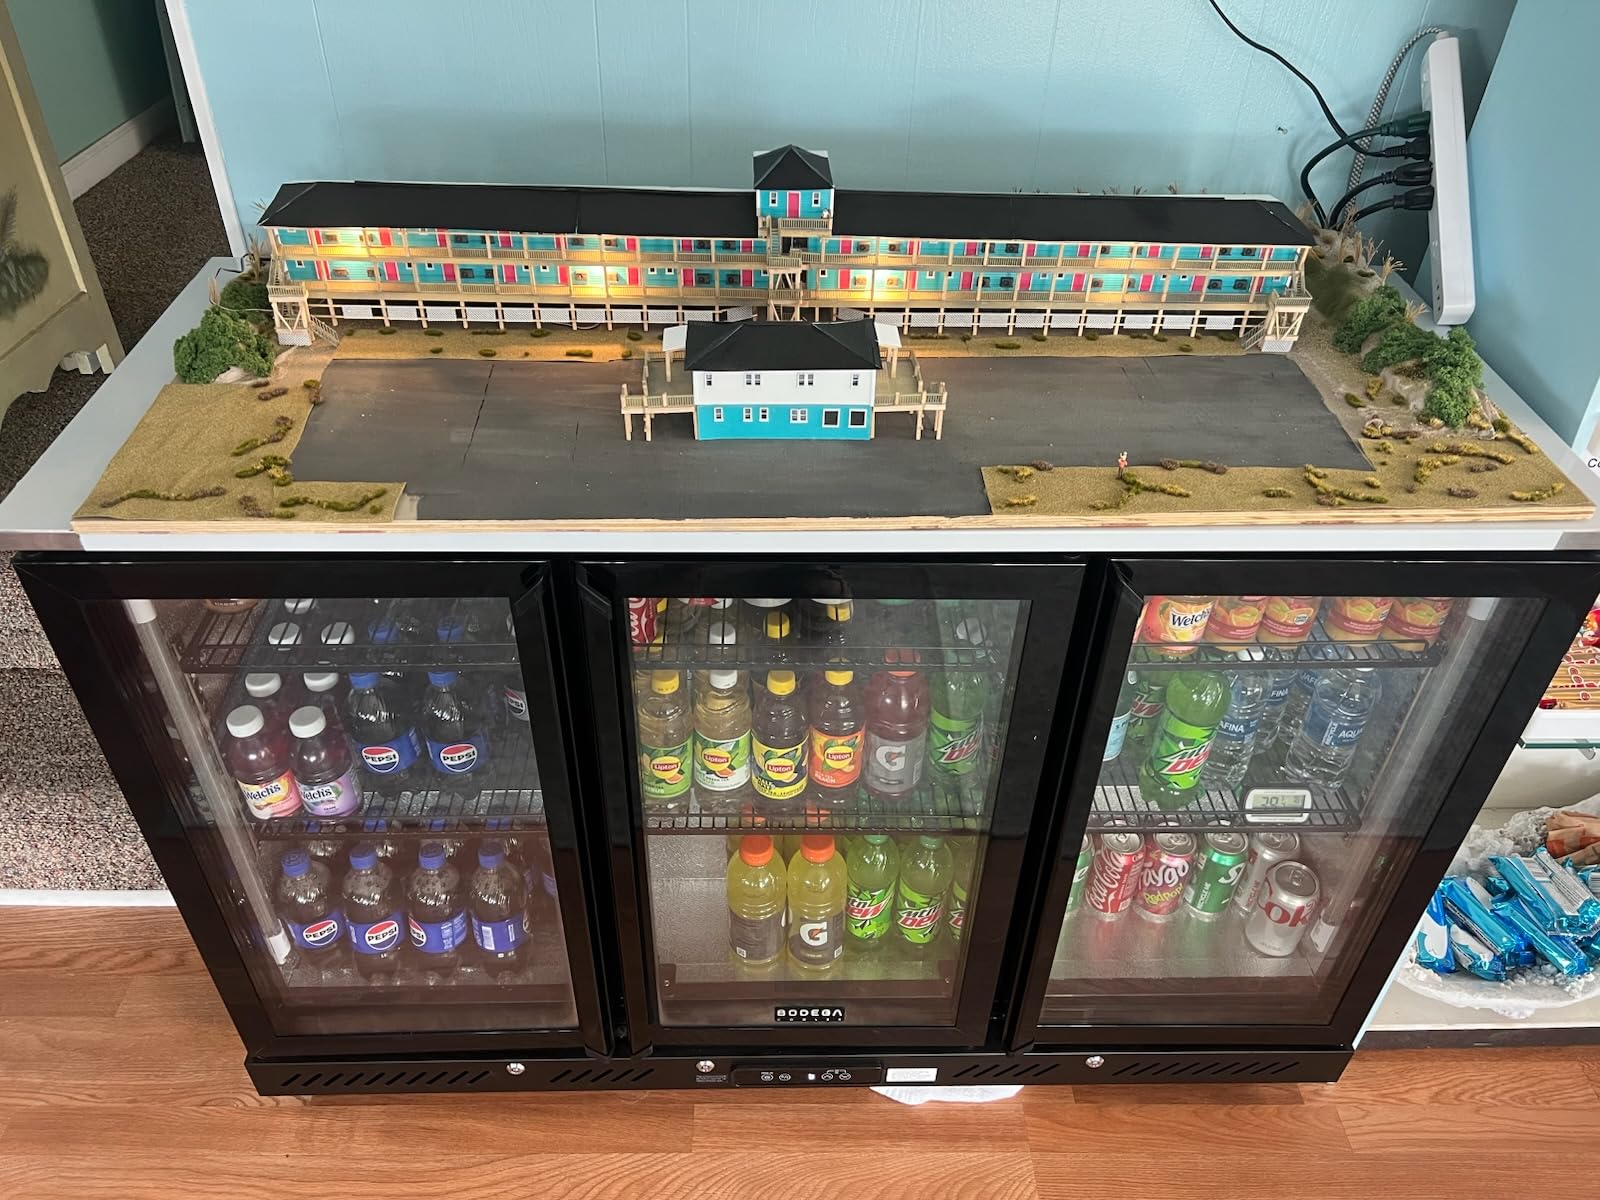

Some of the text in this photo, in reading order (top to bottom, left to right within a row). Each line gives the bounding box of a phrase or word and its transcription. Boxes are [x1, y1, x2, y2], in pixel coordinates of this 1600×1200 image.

[1271, 688, 1288, 697] FINA
[1219, 720, 1245, 732] AFINA
[364, 754, 397, 762] PEPSI
[442, 750, 476, 762] PEPSI
[704, 755, 728, 763] Lipton
[828, 752, 850, 760] Lipton
[654, 763, 678, 771] Lipton
[768, 765, 791, 773] Lipton
[305, 924, 336, 938] PEPSI
[367, 926, 399, 942] PEPSI
[800, 922, 827, 946] G
